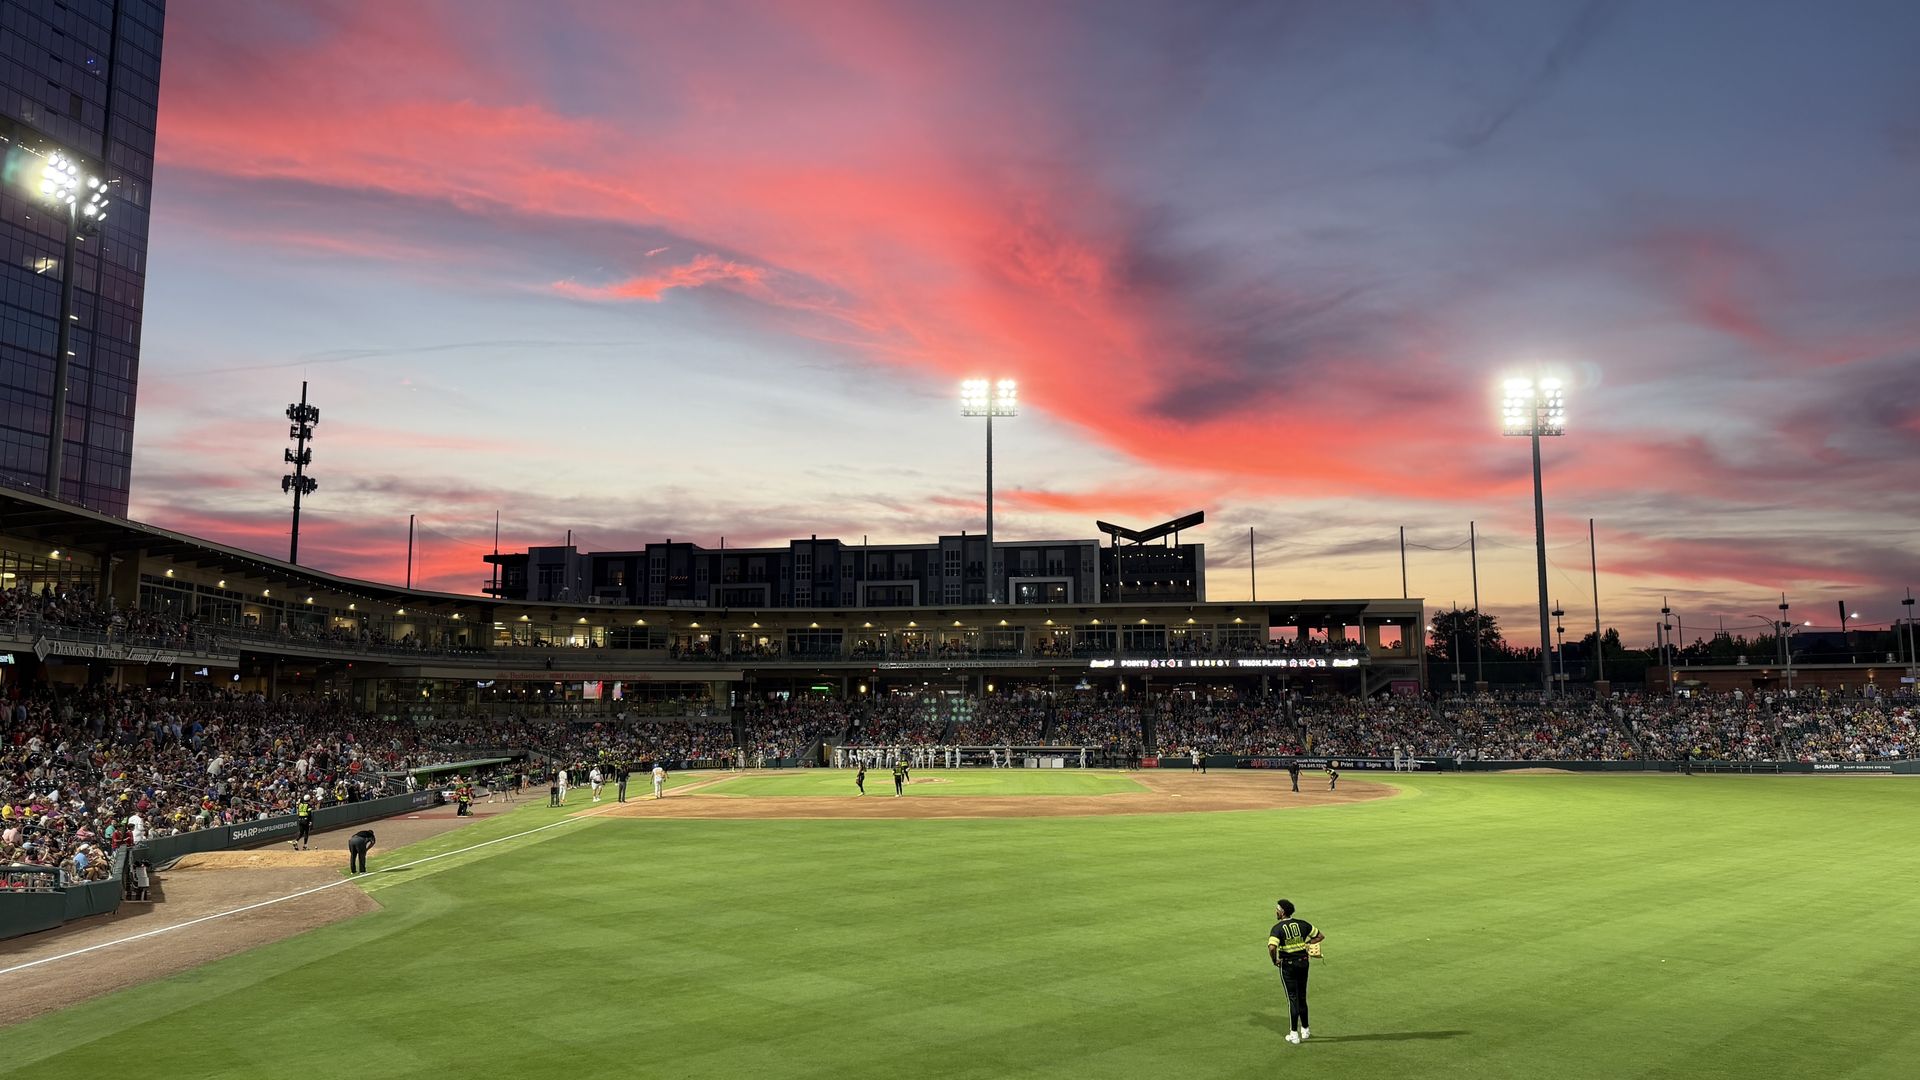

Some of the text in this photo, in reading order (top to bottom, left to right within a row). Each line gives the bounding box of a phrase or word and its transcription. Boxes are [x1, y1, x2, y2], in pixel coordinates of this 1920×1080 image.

[97, 644, 122, 659] DIRECT
[232, 827, 258, 840] SHARP
[1283, 923, 1302, 939] 10
